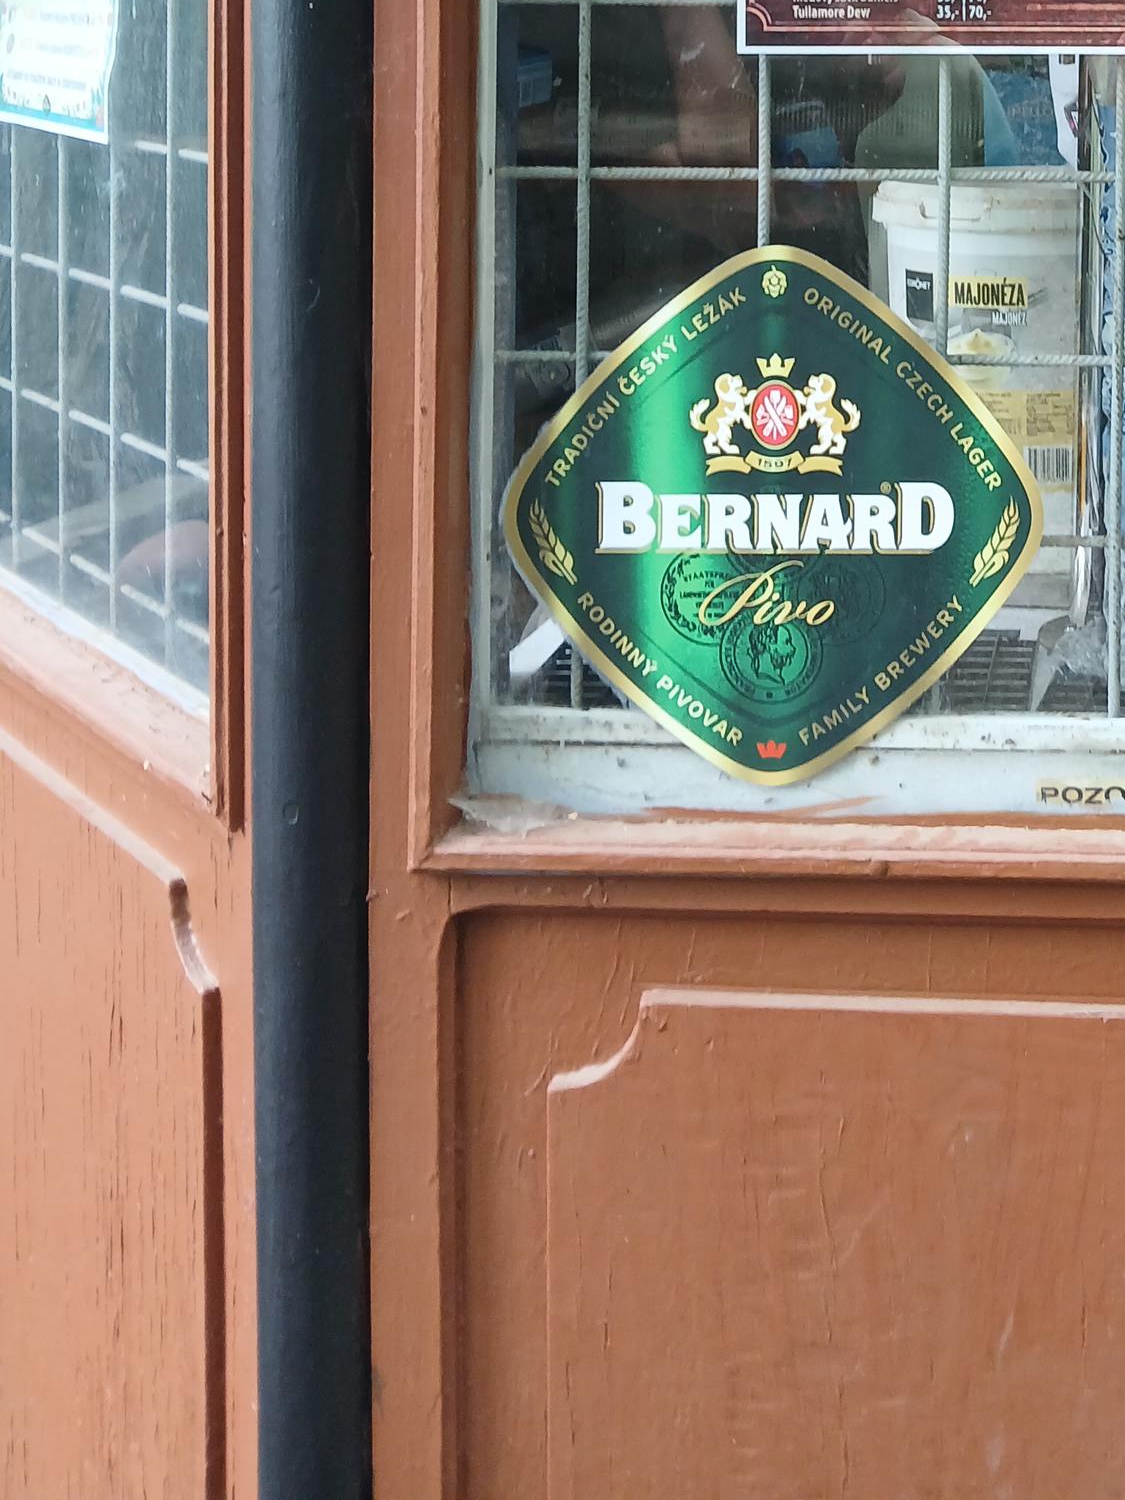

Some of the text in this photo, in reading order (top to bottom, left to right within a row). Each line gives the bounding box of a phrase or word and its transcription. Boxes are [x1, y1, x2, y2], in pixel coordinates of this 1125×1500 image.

[793, 5, 845, 19] Tullamore
[954, 277, 1025, 307] MAJONÉZA
[544, 286, 748, 489] TRADIČNÍ ČESKÝ LEŽÁK
[802, 286, 891, 366] ORIGINAL
[896, 360, 953, 426] CZECH
[949, 421, 1002, 493] LAGER
[595, 480, 955, 554] BERNARD
[699, 560, 836, 628] Pivo
[577, 590, 658, 679] RODINNÝ
[656, 676, 744, 747] PIVOVAR
[798, 689, 871, 747] FAMILY
[873, 595, 966, 692] BREWERY
